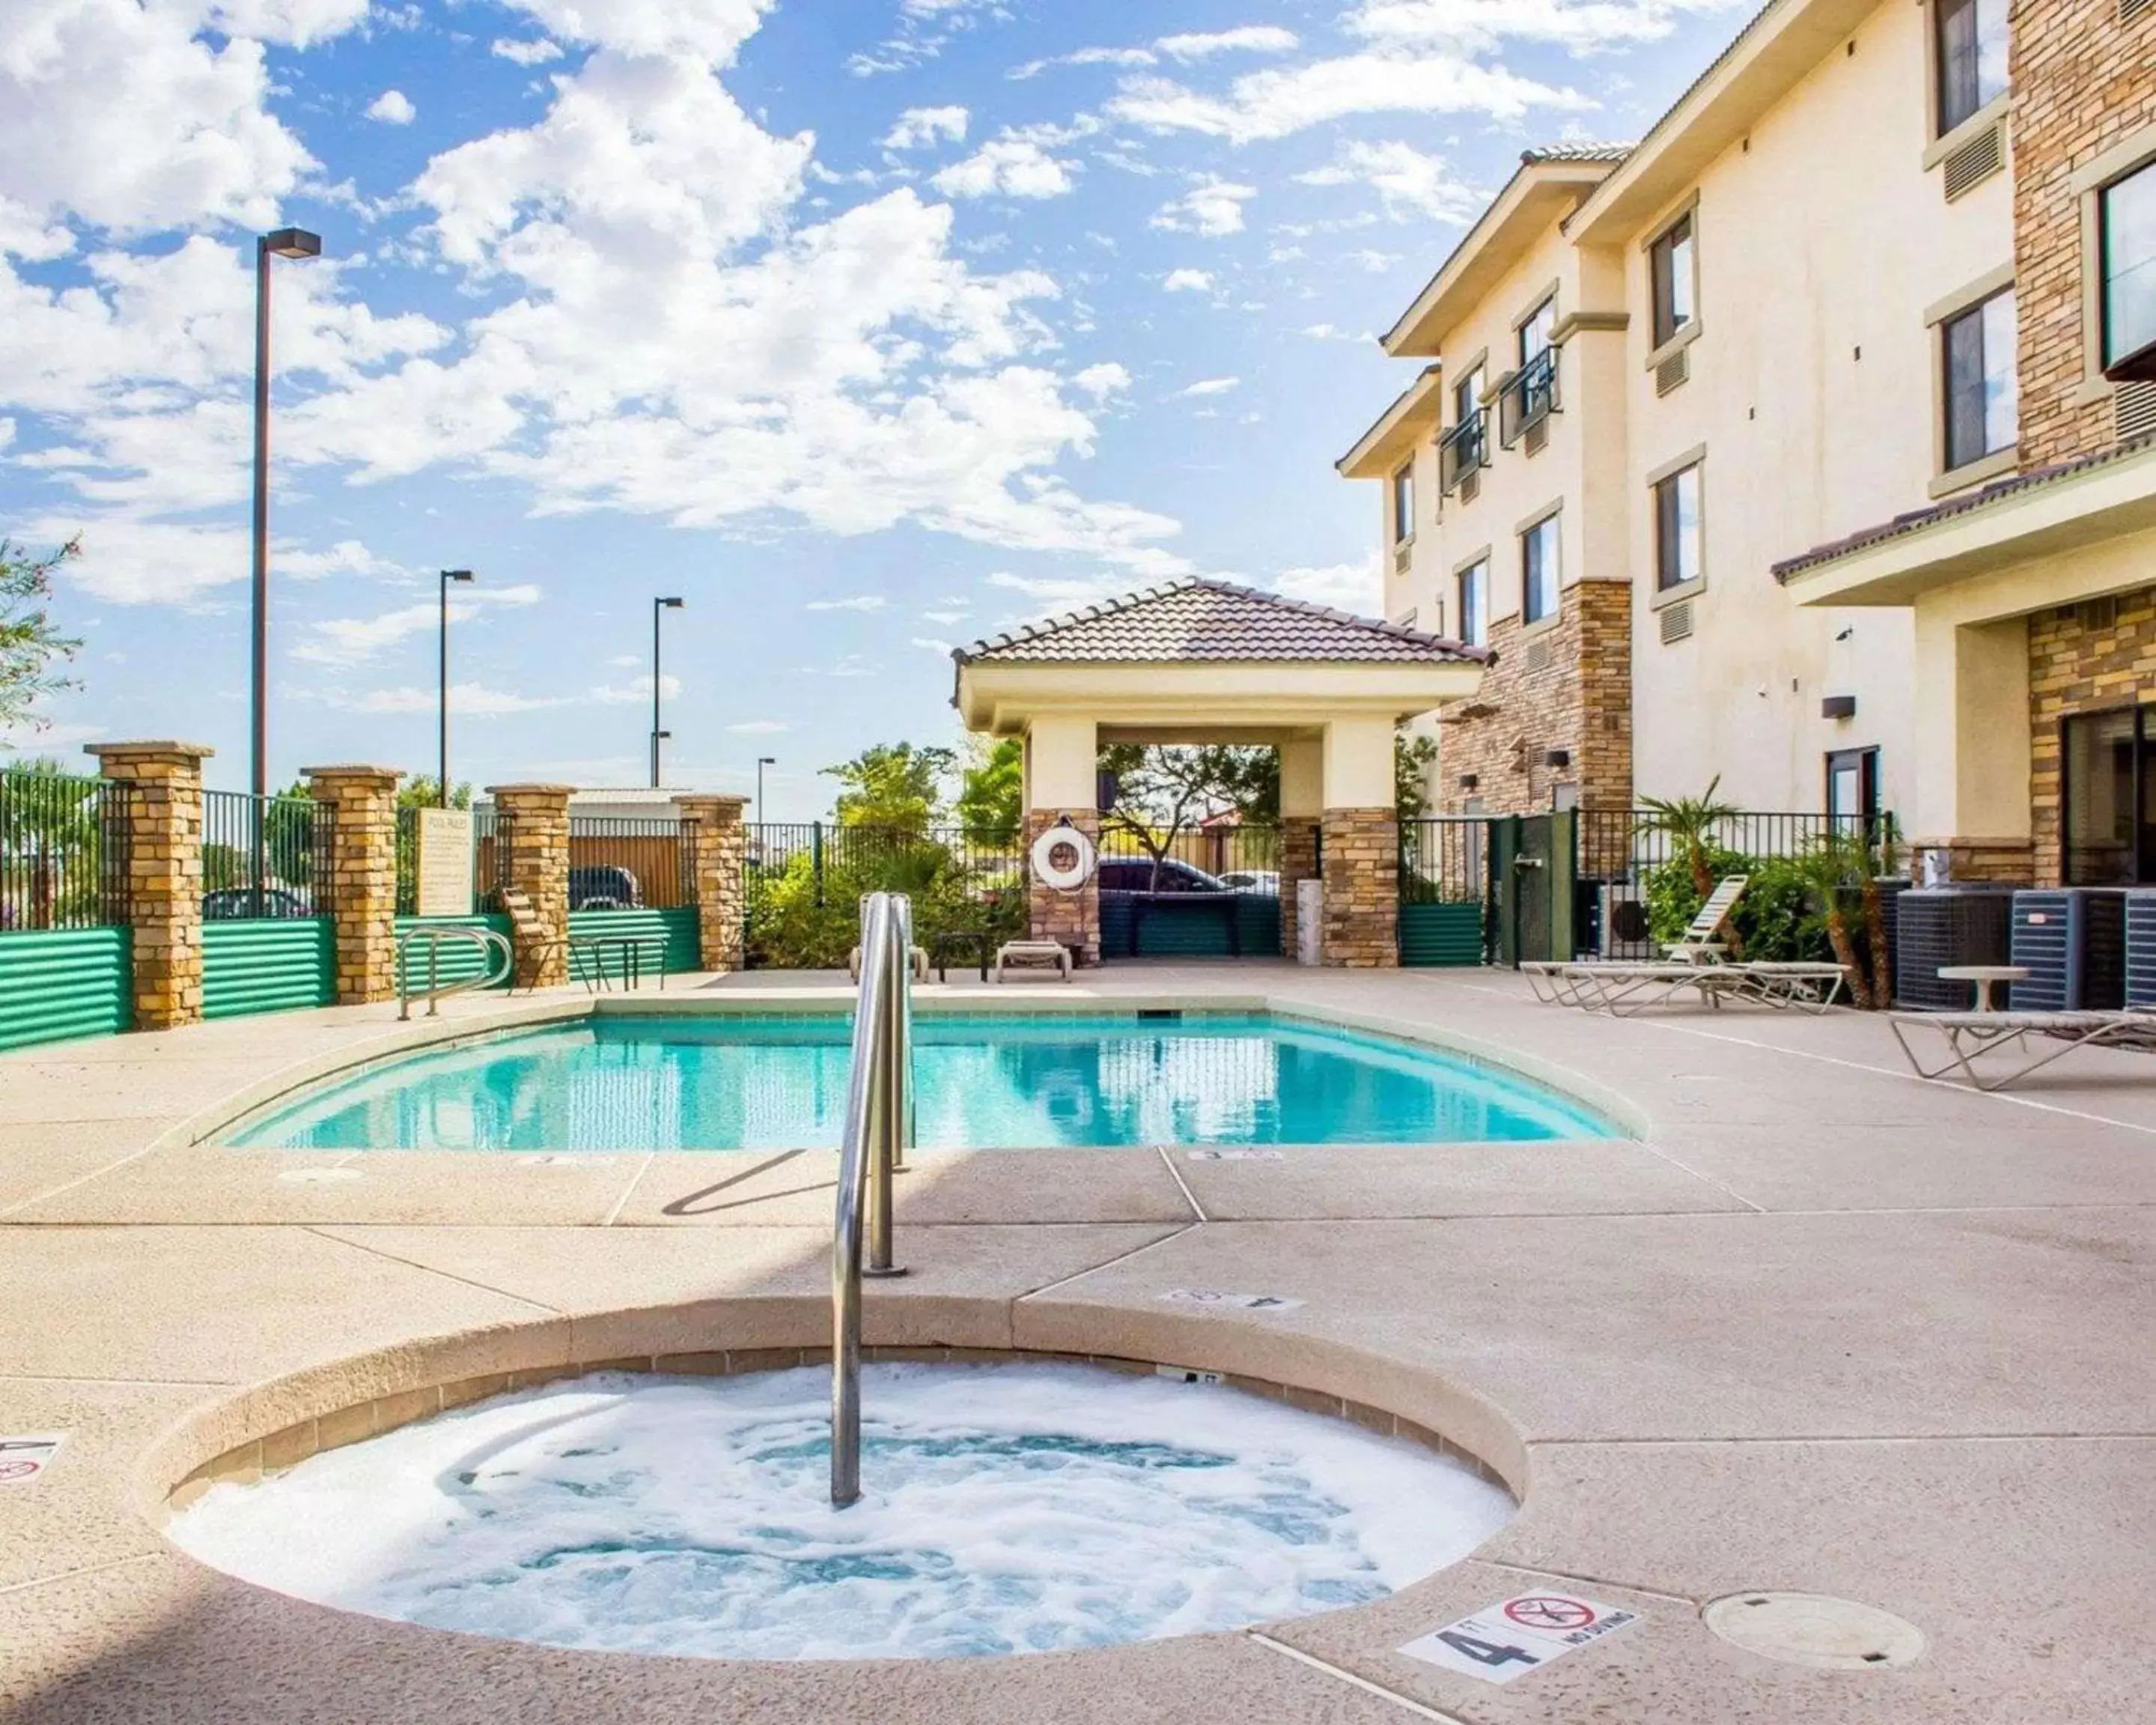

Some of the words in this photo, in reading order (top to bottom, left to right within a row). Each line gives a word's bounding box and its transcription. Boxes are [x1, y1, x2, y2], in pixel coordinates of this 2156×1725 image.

[1457, 1620, 1488, 1633] FT
[1562, 1632, 1592, 1645] NO
[1583, 1611, 1635, 1634] DIVING
[1435, 1631, 1541, 1667] 4
